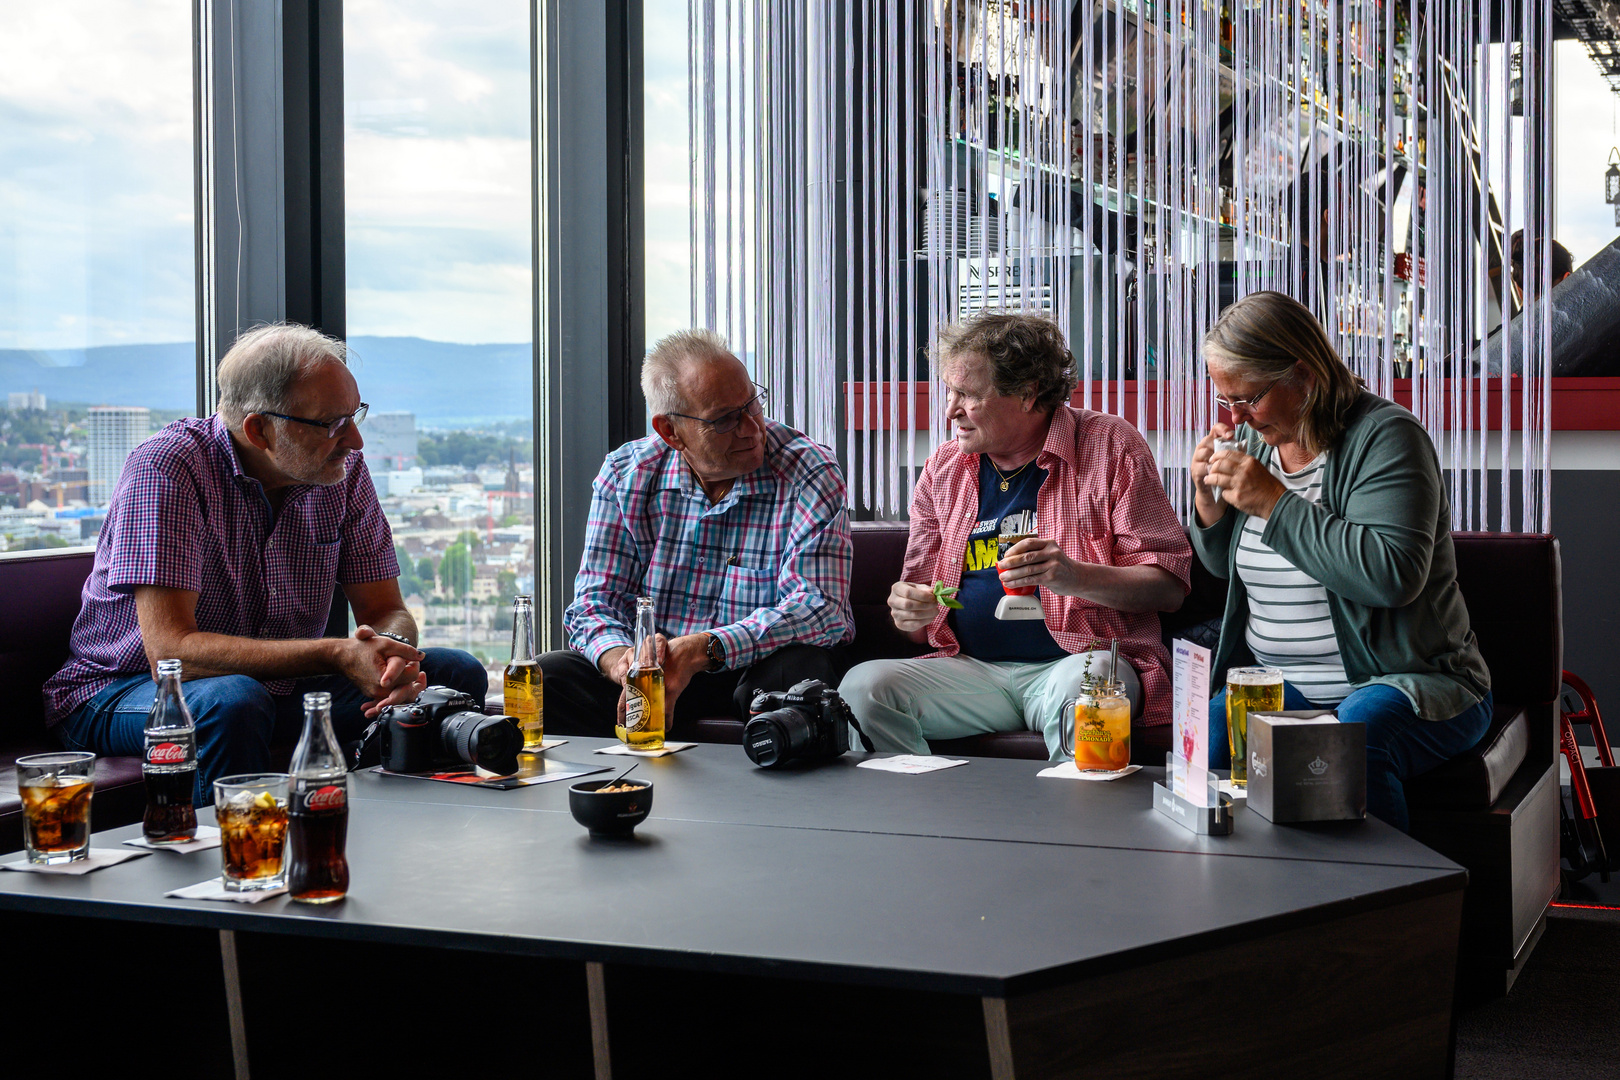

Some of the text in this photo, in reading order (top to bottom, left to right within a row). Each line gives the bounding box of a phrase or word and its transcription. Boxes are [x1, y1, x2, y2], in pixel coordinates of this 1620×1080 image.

[971, 524, 996, 535] NDOORS
[752, 739, 773, 749] TAMRON
[147, 743, 190, 761] Coca-Cola
